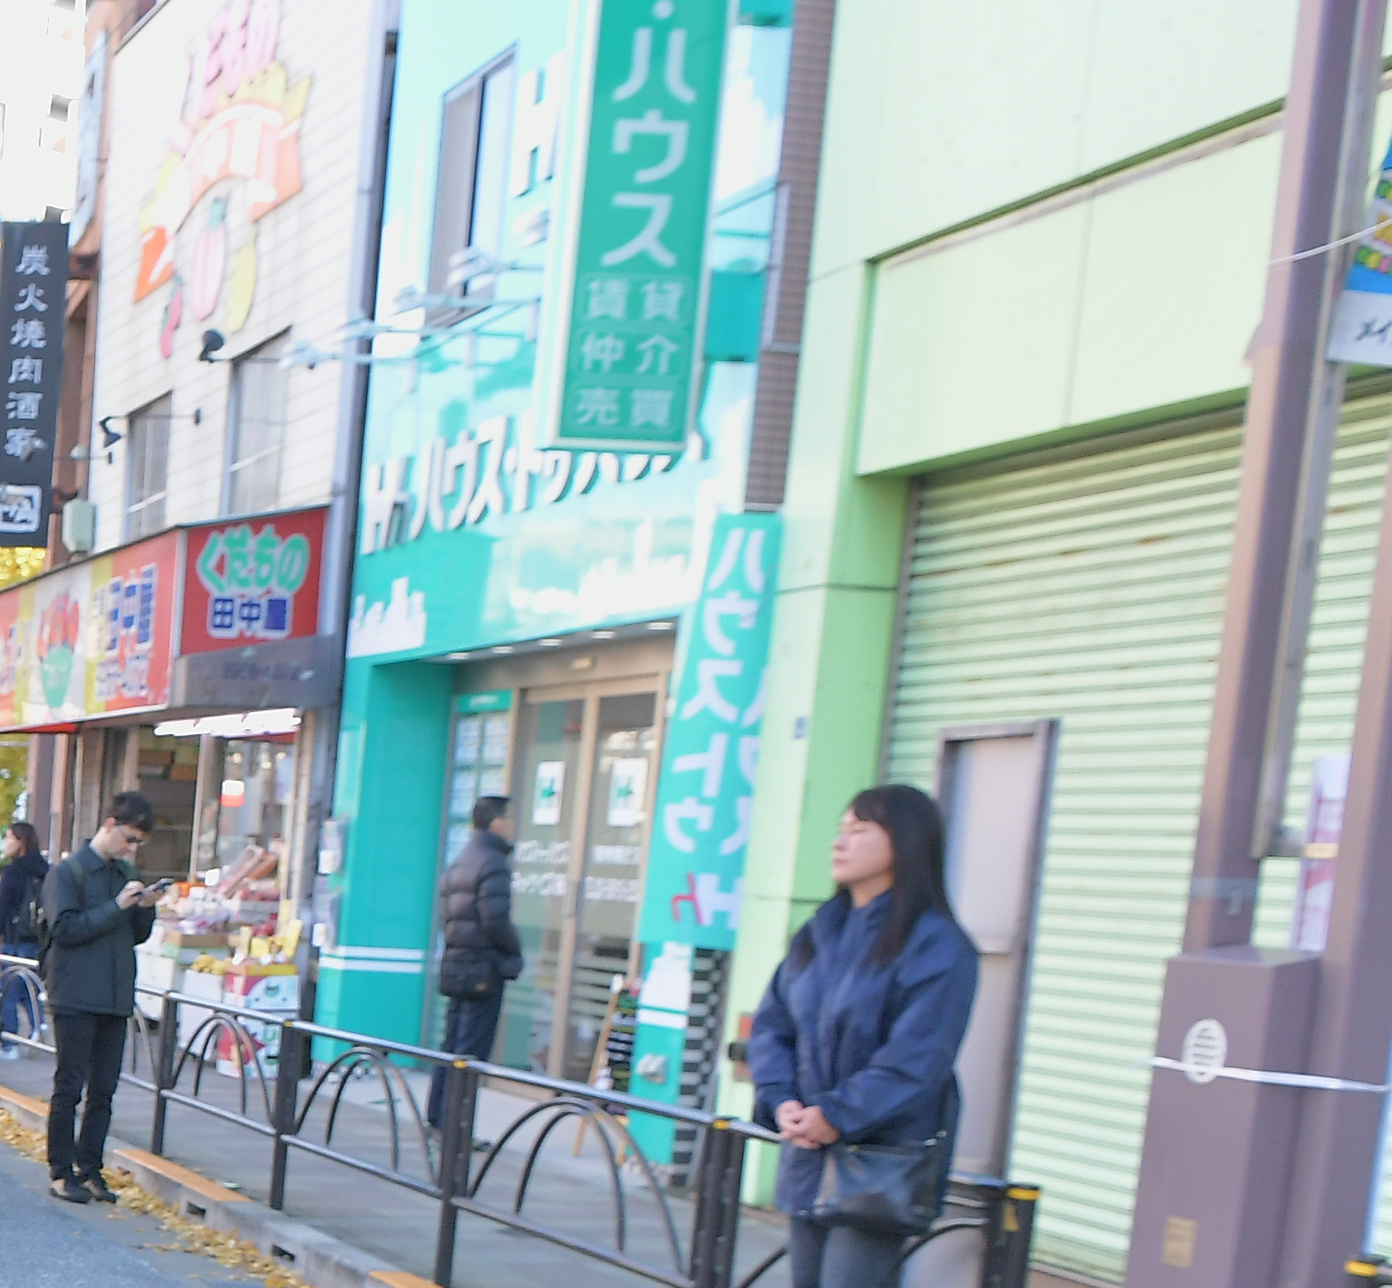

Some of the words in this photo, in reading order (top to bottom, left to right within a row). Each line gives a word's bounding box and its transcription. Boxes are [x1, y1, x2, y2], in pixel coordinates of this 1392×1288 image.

[586, 279, 684, 323] 賃貸
[581, 332, 680, 374] 仲介
[575, 386, 674, 428] 売買
[198, 525, 308, 593] くだもの
